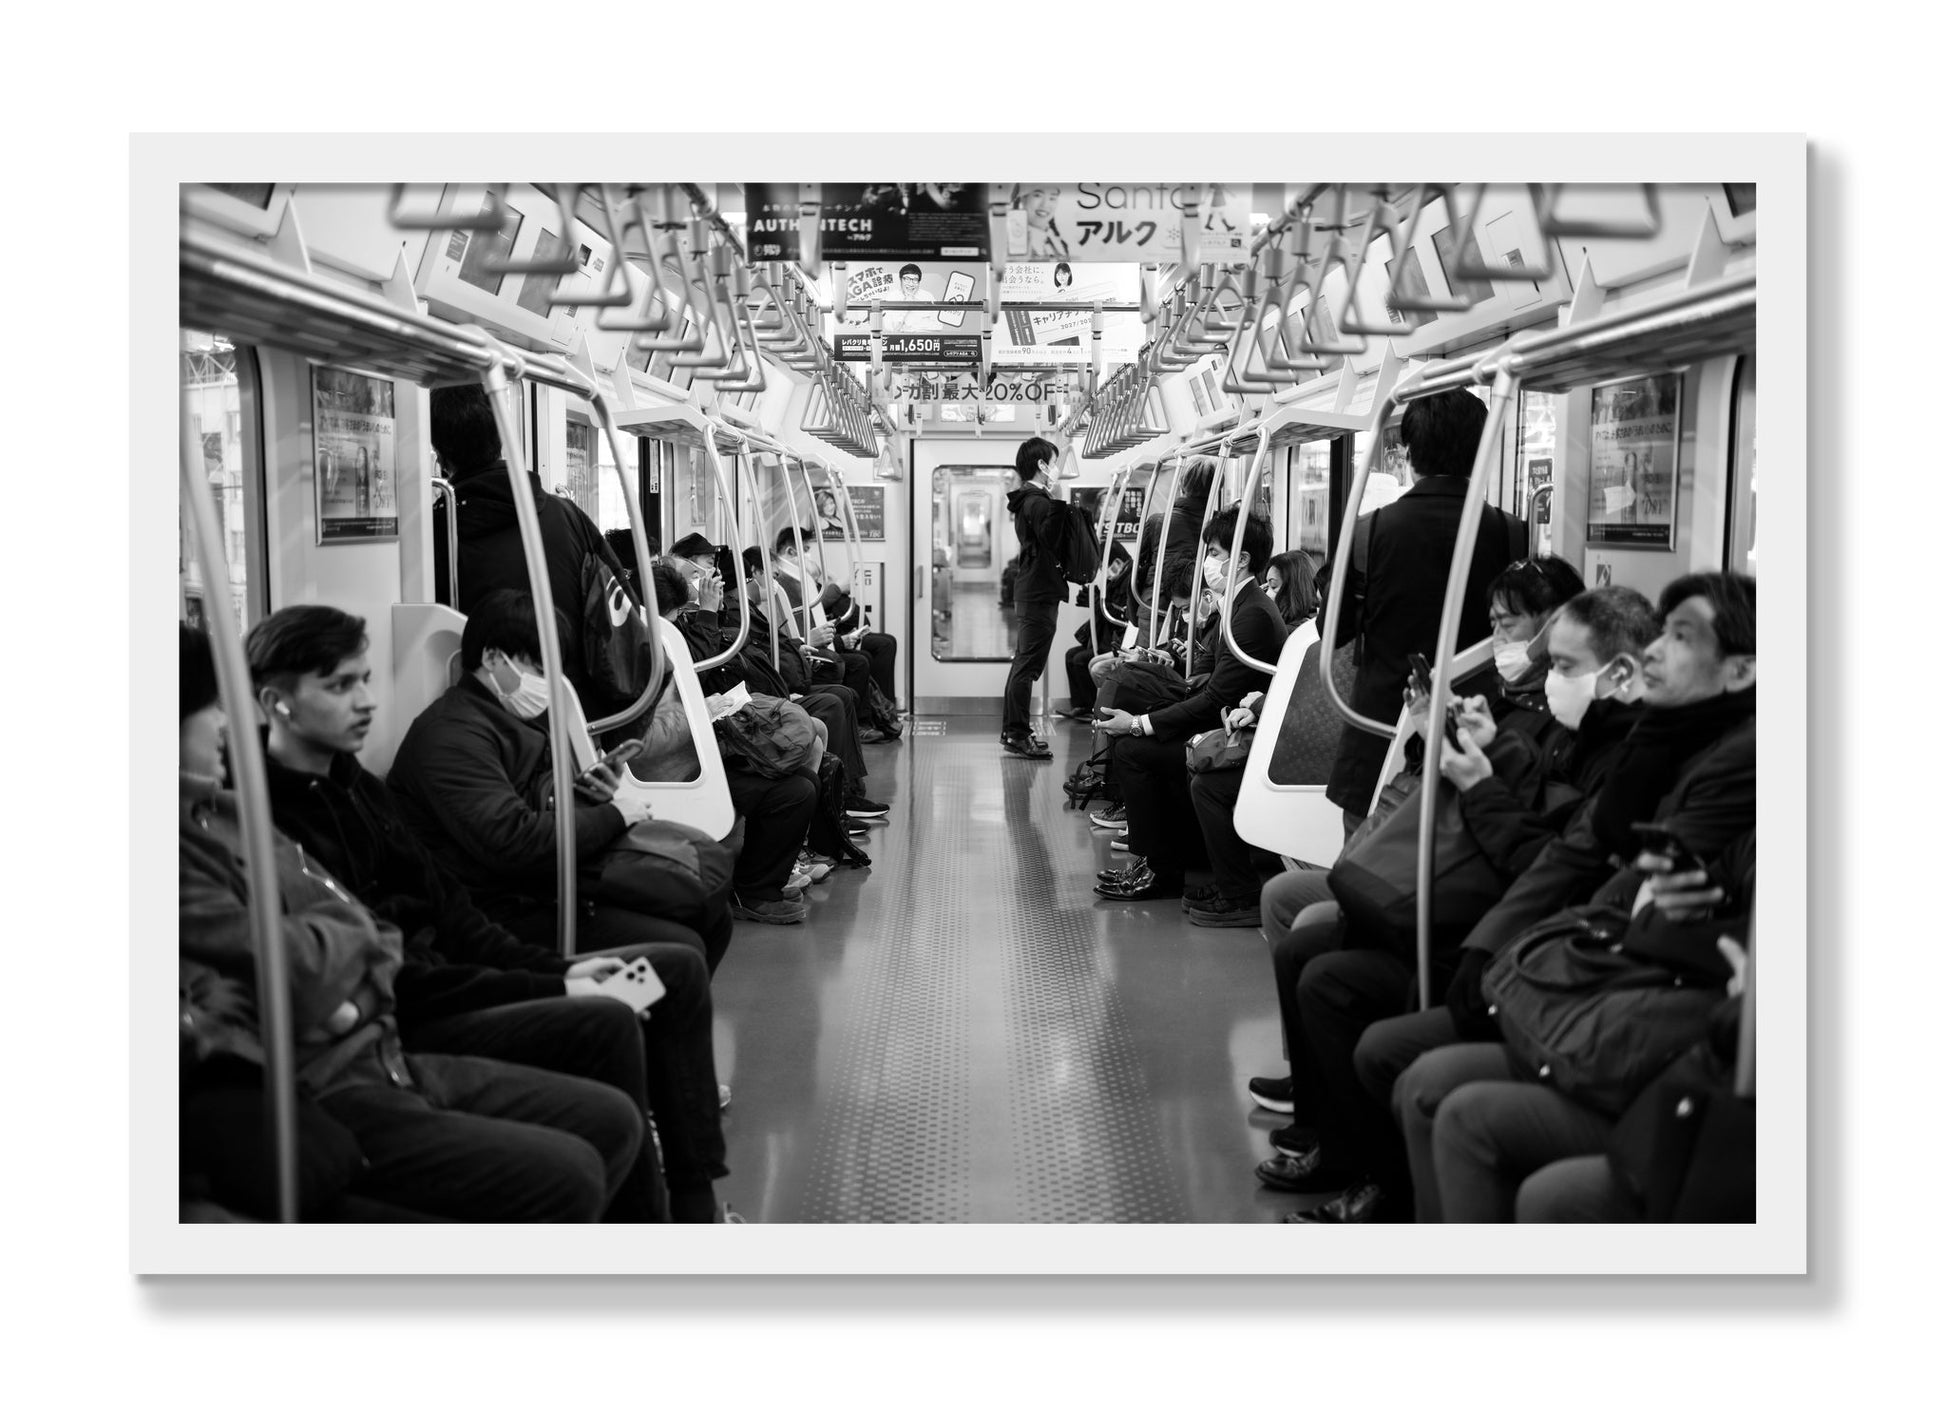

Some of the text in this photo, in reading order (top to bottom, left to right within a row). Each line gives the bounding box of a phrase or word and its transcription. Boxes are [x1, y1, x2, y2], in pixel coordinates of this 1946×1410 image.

[754, 219, 872, 232] AUTHTECH
[1077, 221, 1157, 247] アルク
[848, 267, 883, 288] スマホで
